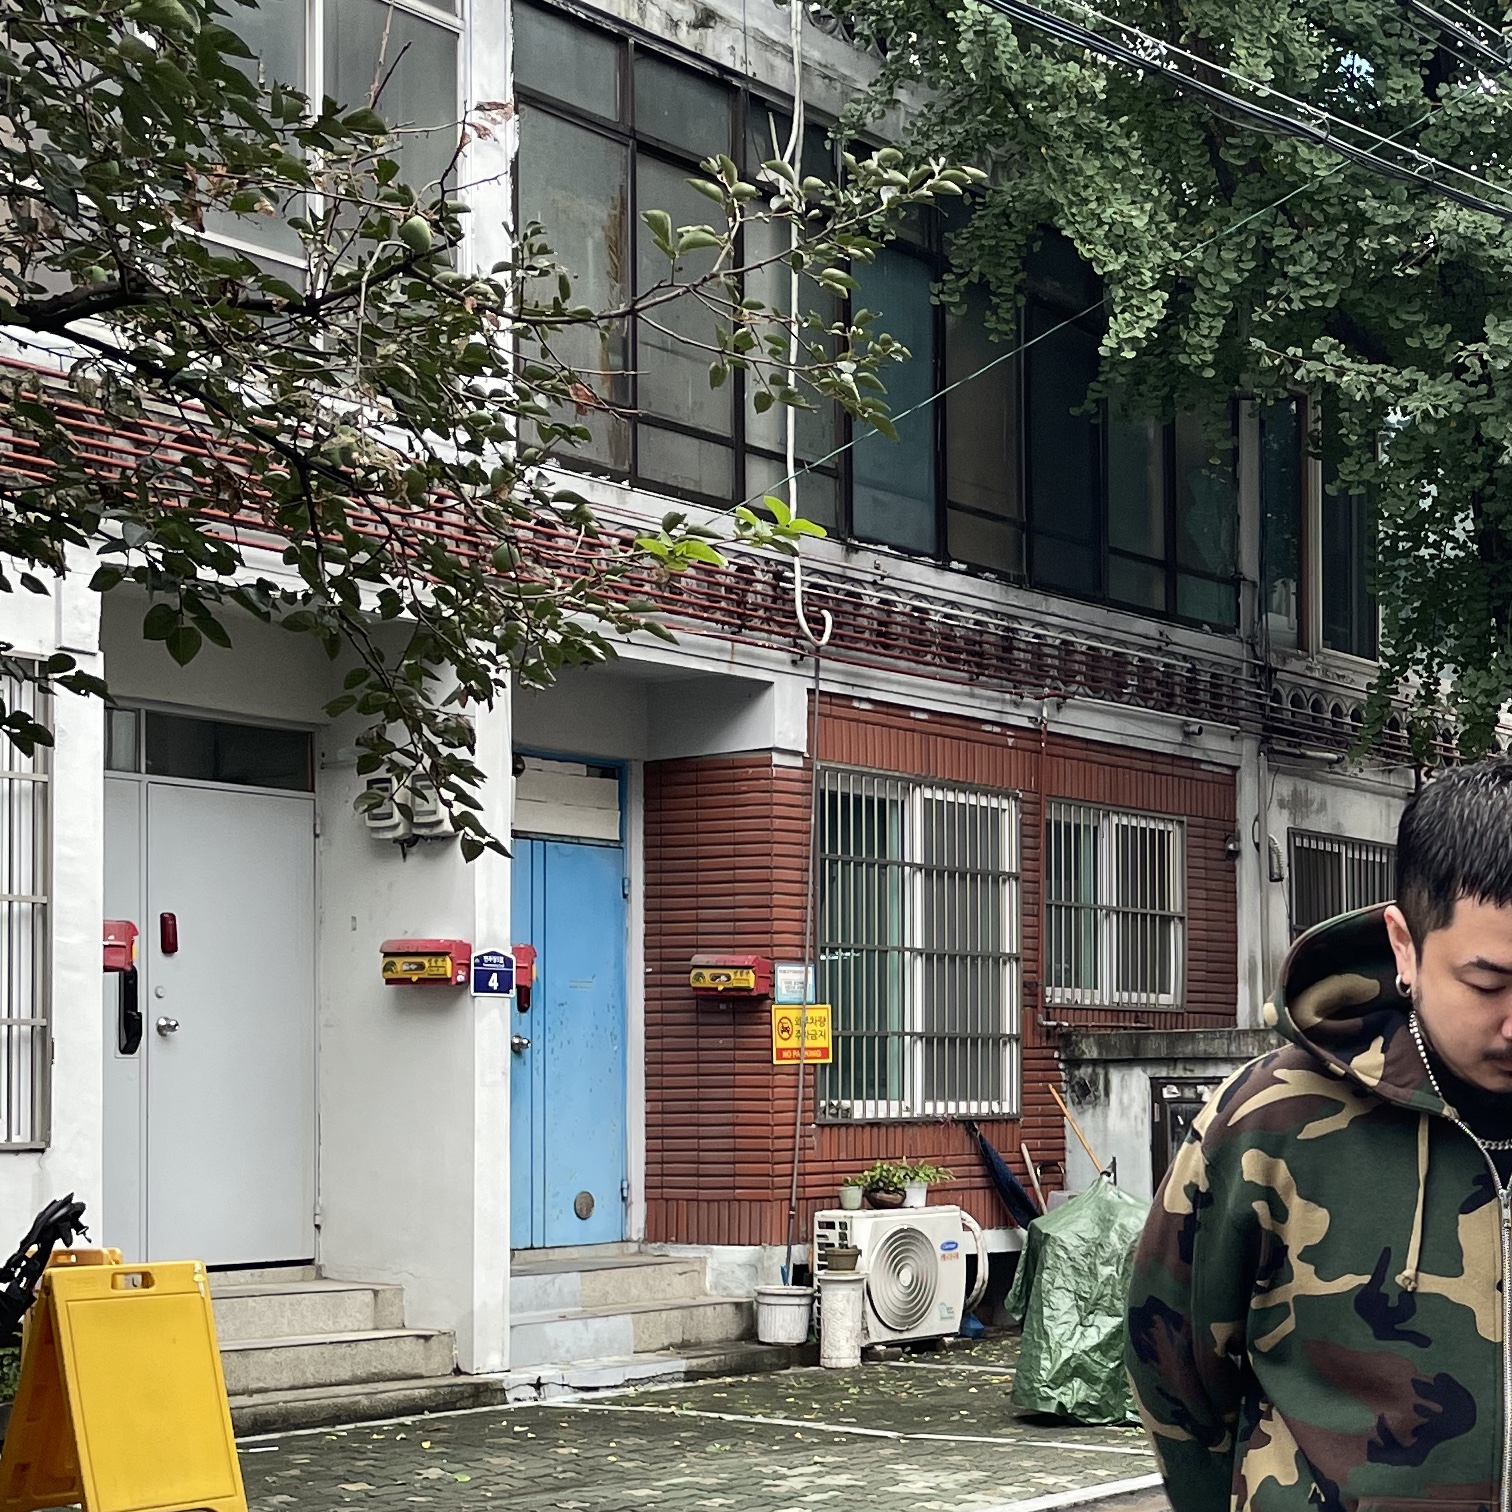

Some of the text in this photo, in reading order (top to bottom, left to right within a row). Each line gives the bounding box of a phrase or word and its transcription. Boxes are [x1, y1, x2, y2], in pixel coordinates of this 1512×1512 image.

[488, 972, 499, 990] 4
[795, 1029, 827, 1041] 주금지
[793, 1050, 822, 1058] PAKING
